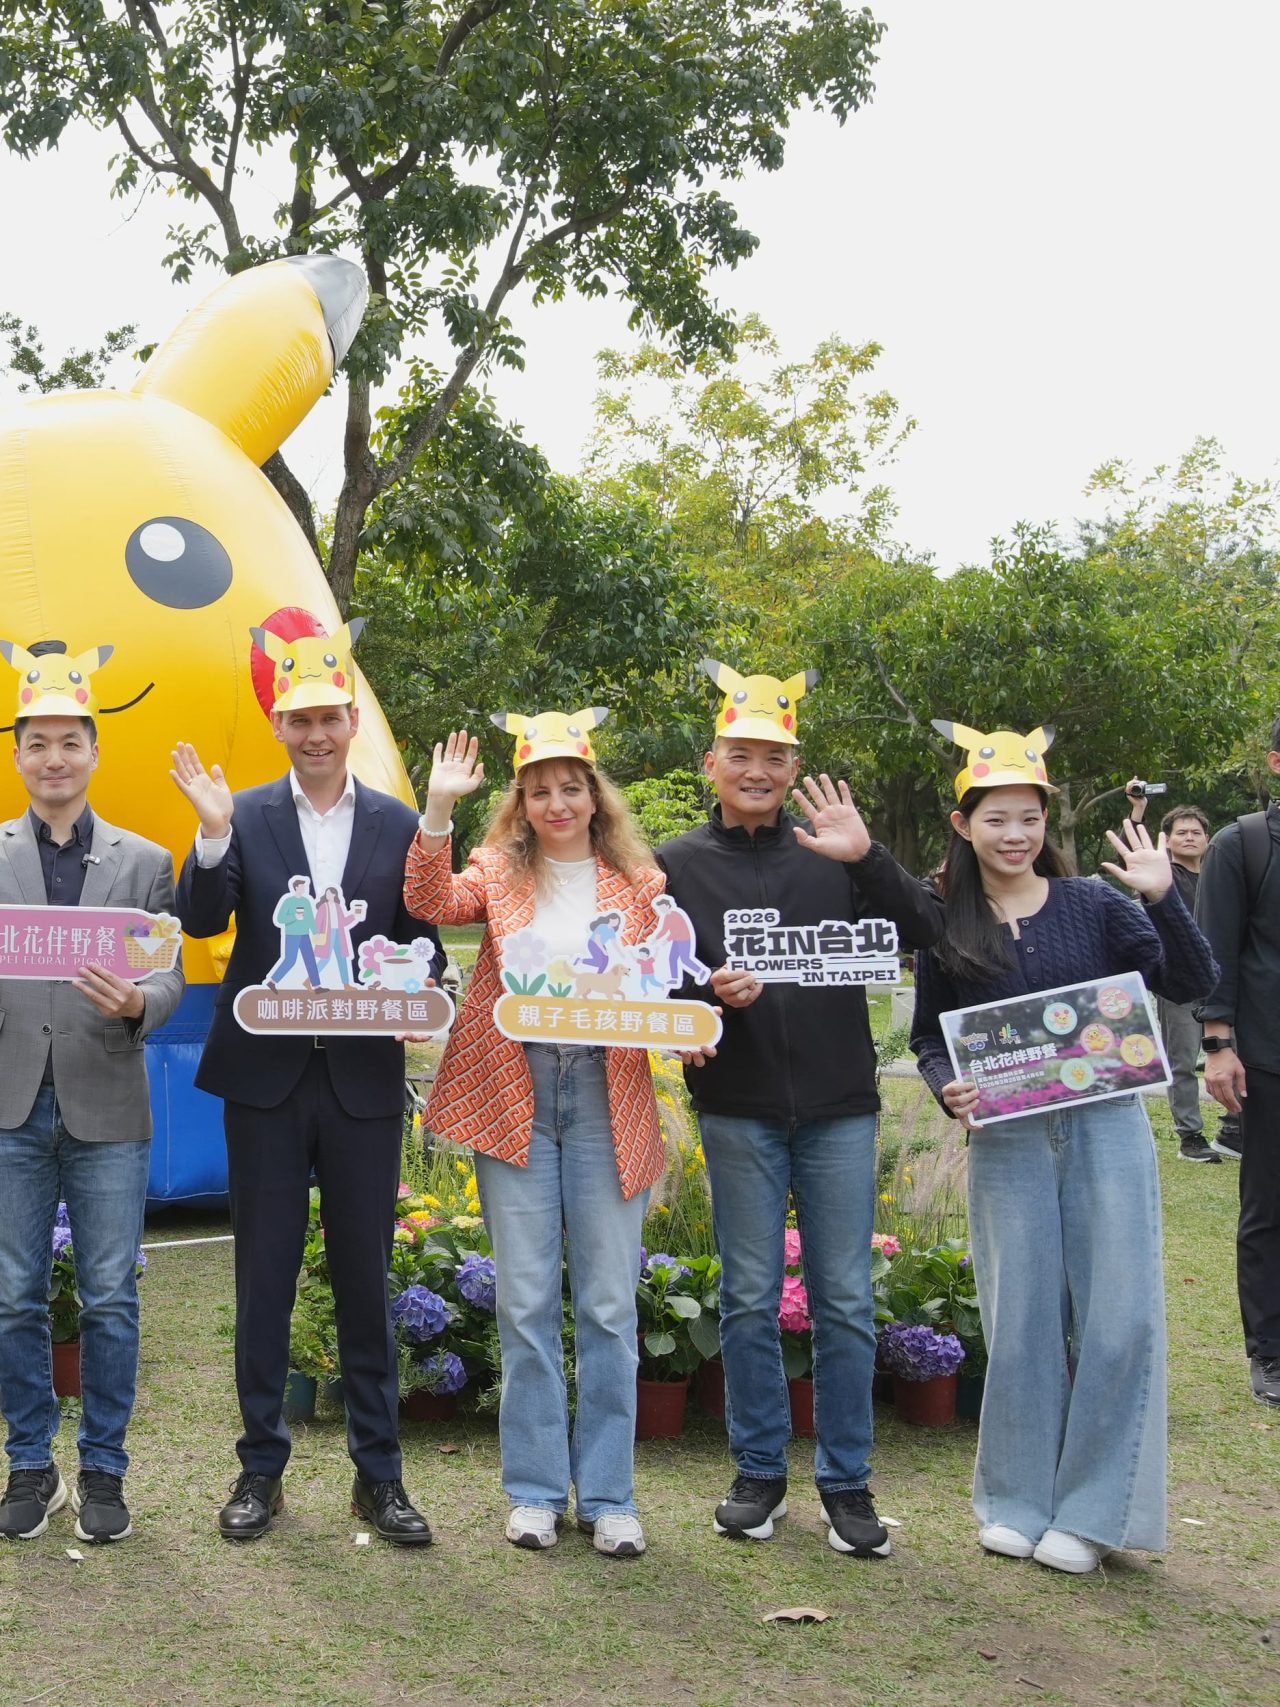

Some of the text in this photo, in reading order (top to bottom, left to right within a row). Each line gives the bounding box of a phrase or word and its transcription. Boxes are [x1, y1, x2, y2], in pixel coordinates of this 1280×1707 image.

[728, 912, 776, 924] 2026
[728, 922, 894, 957] 花IN台北
[24, 956, 66, 966] FLORAL
[74, 957, 116, 967] PICNIC
[731, 958, 823, 971] FLOWERS
[802, 970, 897, 982] IN TAIPEI
[257, 998, 429, 1021] 咖啡派對野餐區
[517, 1004, 696, 1036] 親子毛孩野餐區
[968, 1043, 1058, 1074] 台北花伴野餐
